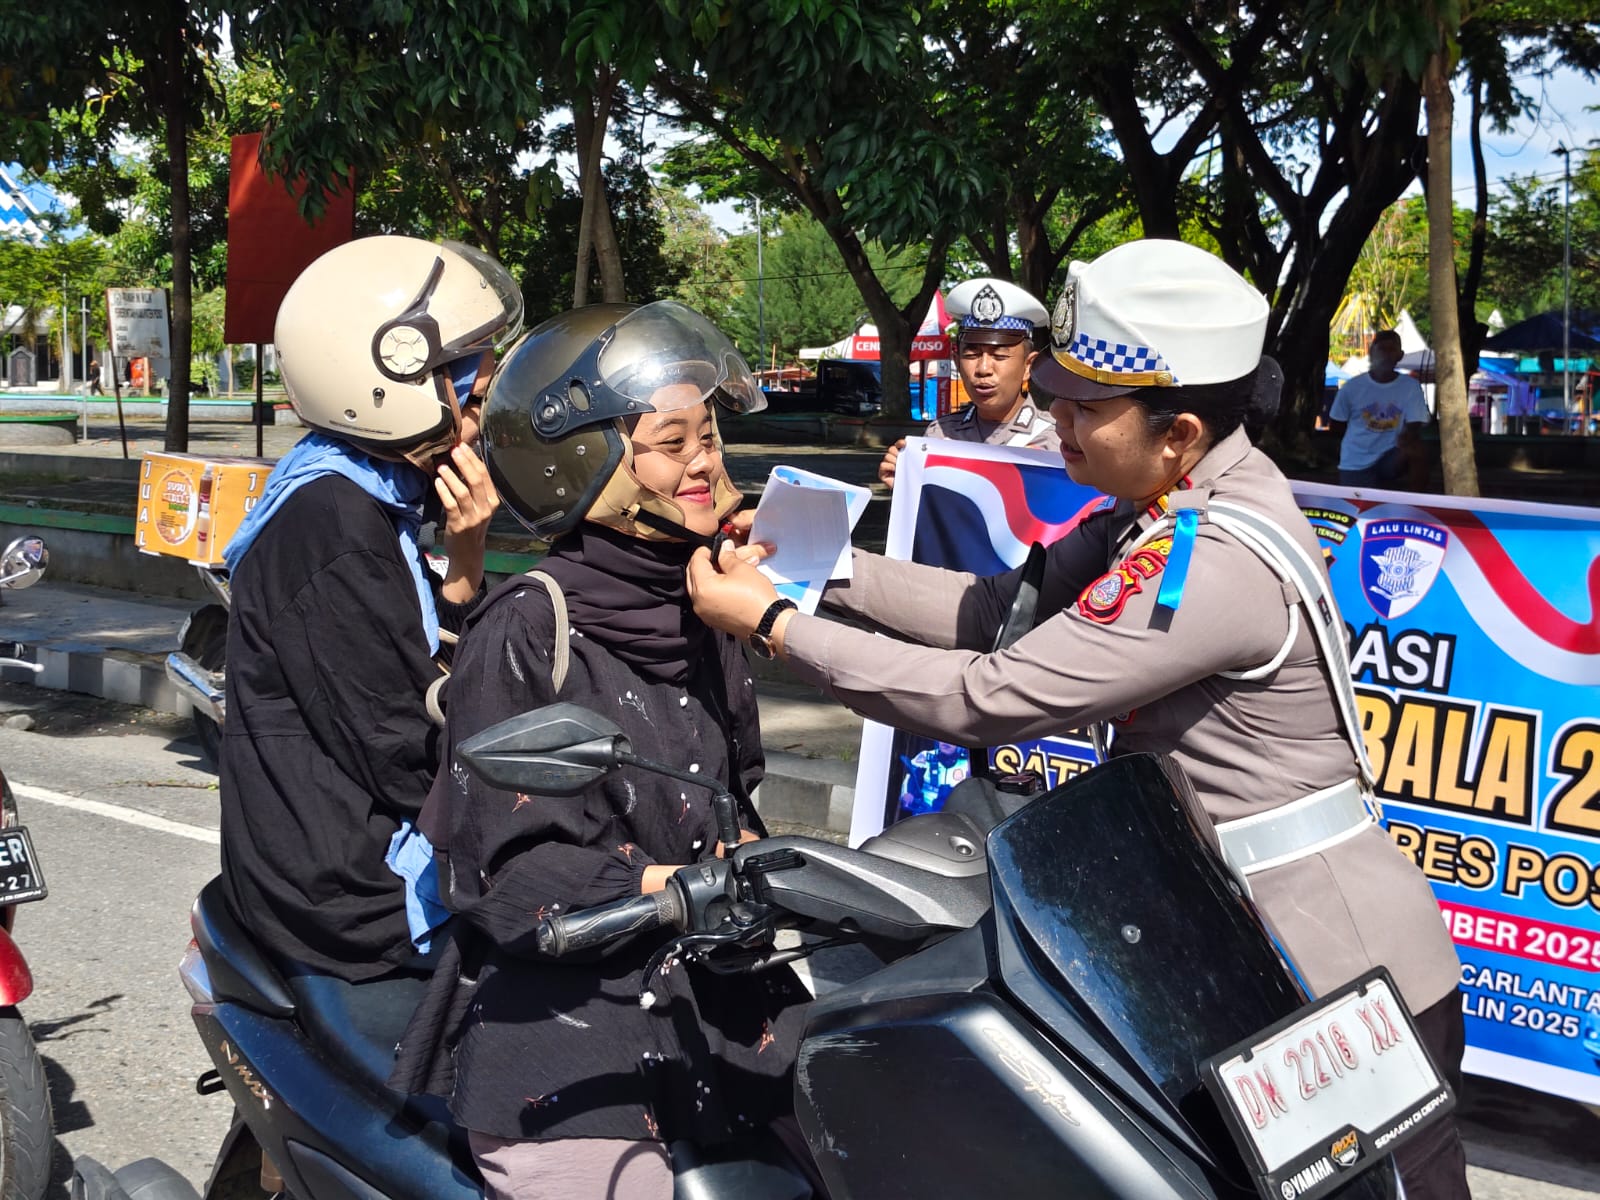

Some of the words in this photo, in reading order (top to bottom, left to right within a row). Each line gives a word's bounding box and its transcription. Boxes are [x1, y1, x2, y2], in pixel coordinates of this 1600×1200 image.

[911, 341, 943, 351] POSO
[139, 461, 152, 545] JUAL
[1322, 511, 1349, 523] POSO
[1371, 523, 1400, 535] LALU
[1403, 524, 1442, 542] LINTAS
[1350, 629, 1450, 688] ASI
[995, 748, 1090, 786] SAT
[1505, 847, 1600, 909] PO
[1511, 1005, 1579, 1038] 2025
[1234, 1064, 1289, 1129] DN
[1355, 996, 1403, 1056] XX
[1290, 1157, 1335, 1195] YAMAHA
